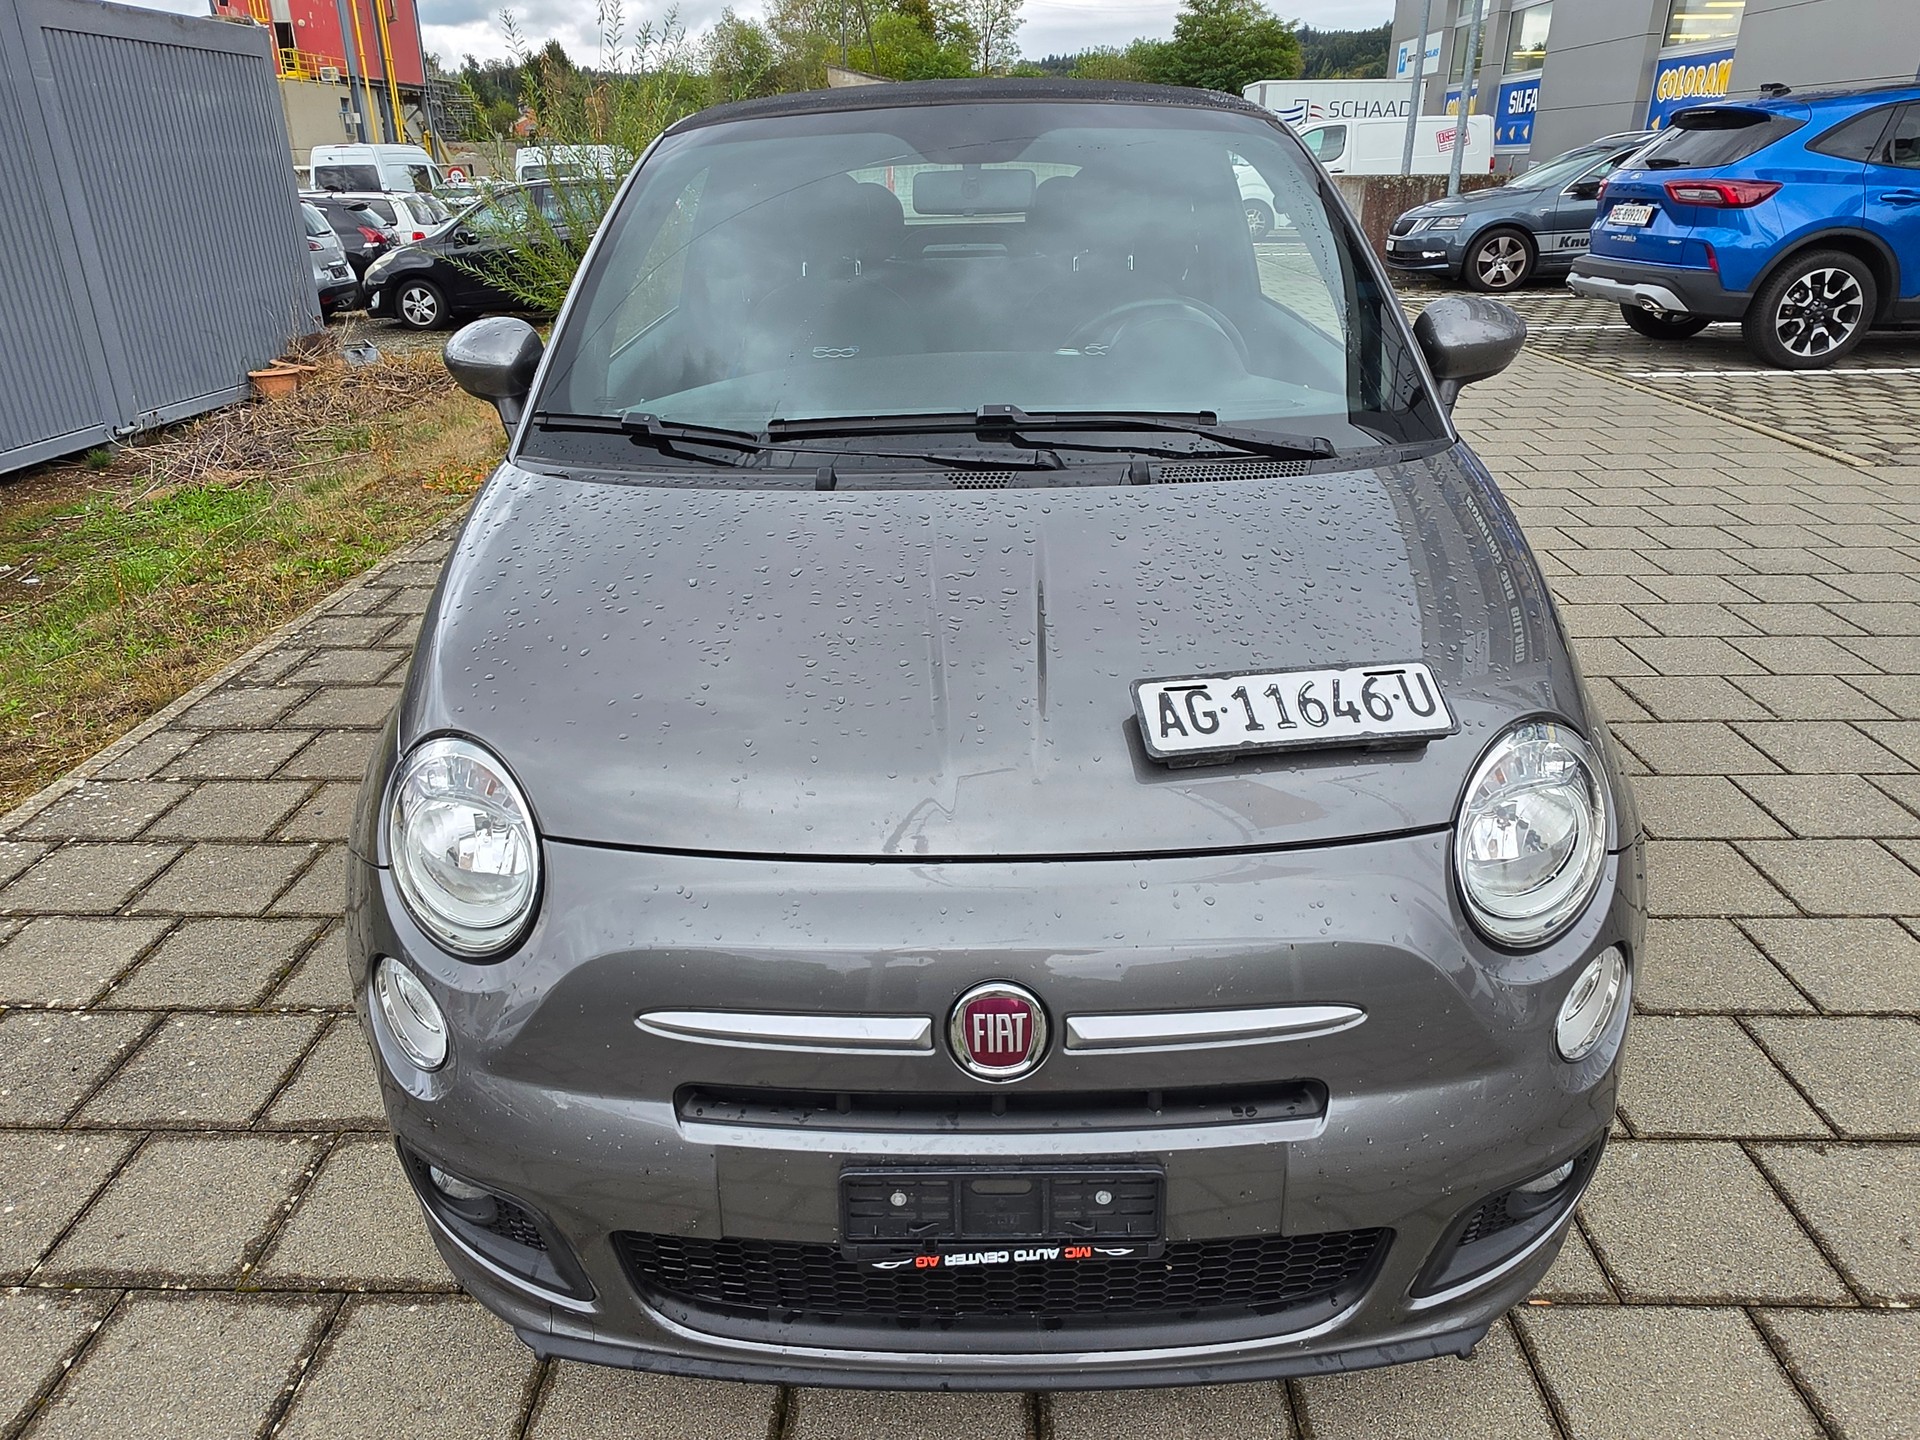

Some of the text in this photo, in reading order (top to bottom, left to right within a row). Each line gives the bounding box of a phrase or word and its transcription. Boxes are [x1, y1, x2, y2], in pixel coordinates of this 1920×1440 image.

[1656, 58, 1734, 103] COLORAM
[1328, 100, 1411, 118] SCHAAD
[1508, 88, 1539, 114] SILFA
[972, 1012, 1028, 1053] FIAT
[915, 1246, 1092, 1268] MC AUTO CENTER AG
